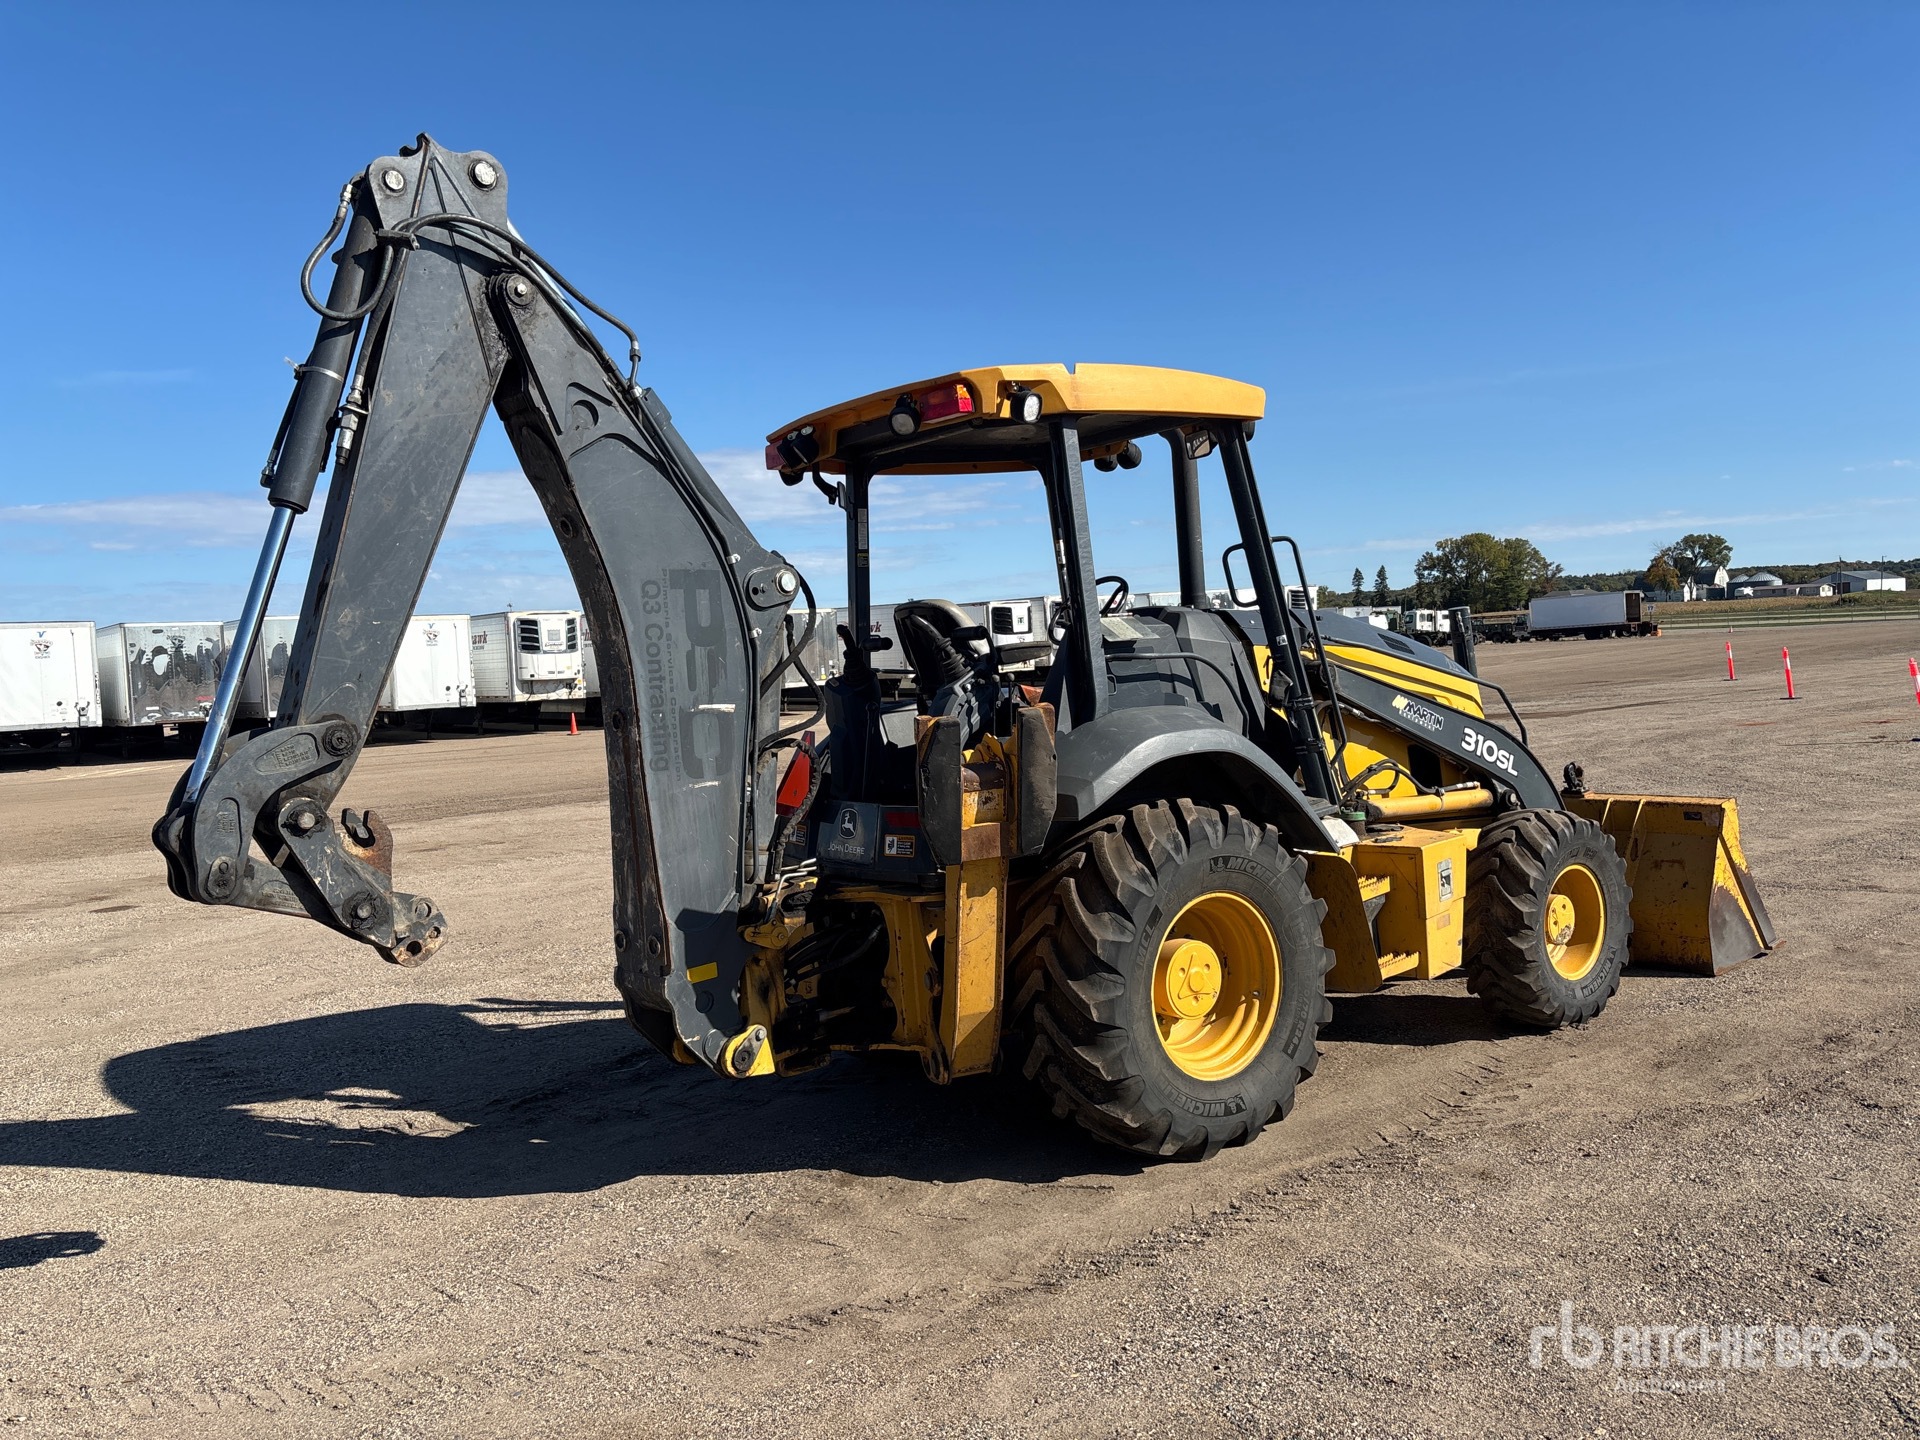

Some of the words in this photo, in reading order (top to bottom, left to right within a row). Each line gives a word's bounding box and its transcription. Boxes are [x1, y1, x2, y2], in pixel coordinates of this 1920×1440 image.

[641, 579, 661, 615] Q3
[665, 633, 676, 693] Services
[645, 624, 670, 772] Contracting
[1403, 699, 1444, 730] MARTIN
[670, 697, 682, 782] Corporation
[1461, 727, 1518, 777] 310SL
[828, 841, 844, 852] JOHN
[844, 843, 866, 855] DEERE
[1583, 960, 1611, 997] MICHELIN
